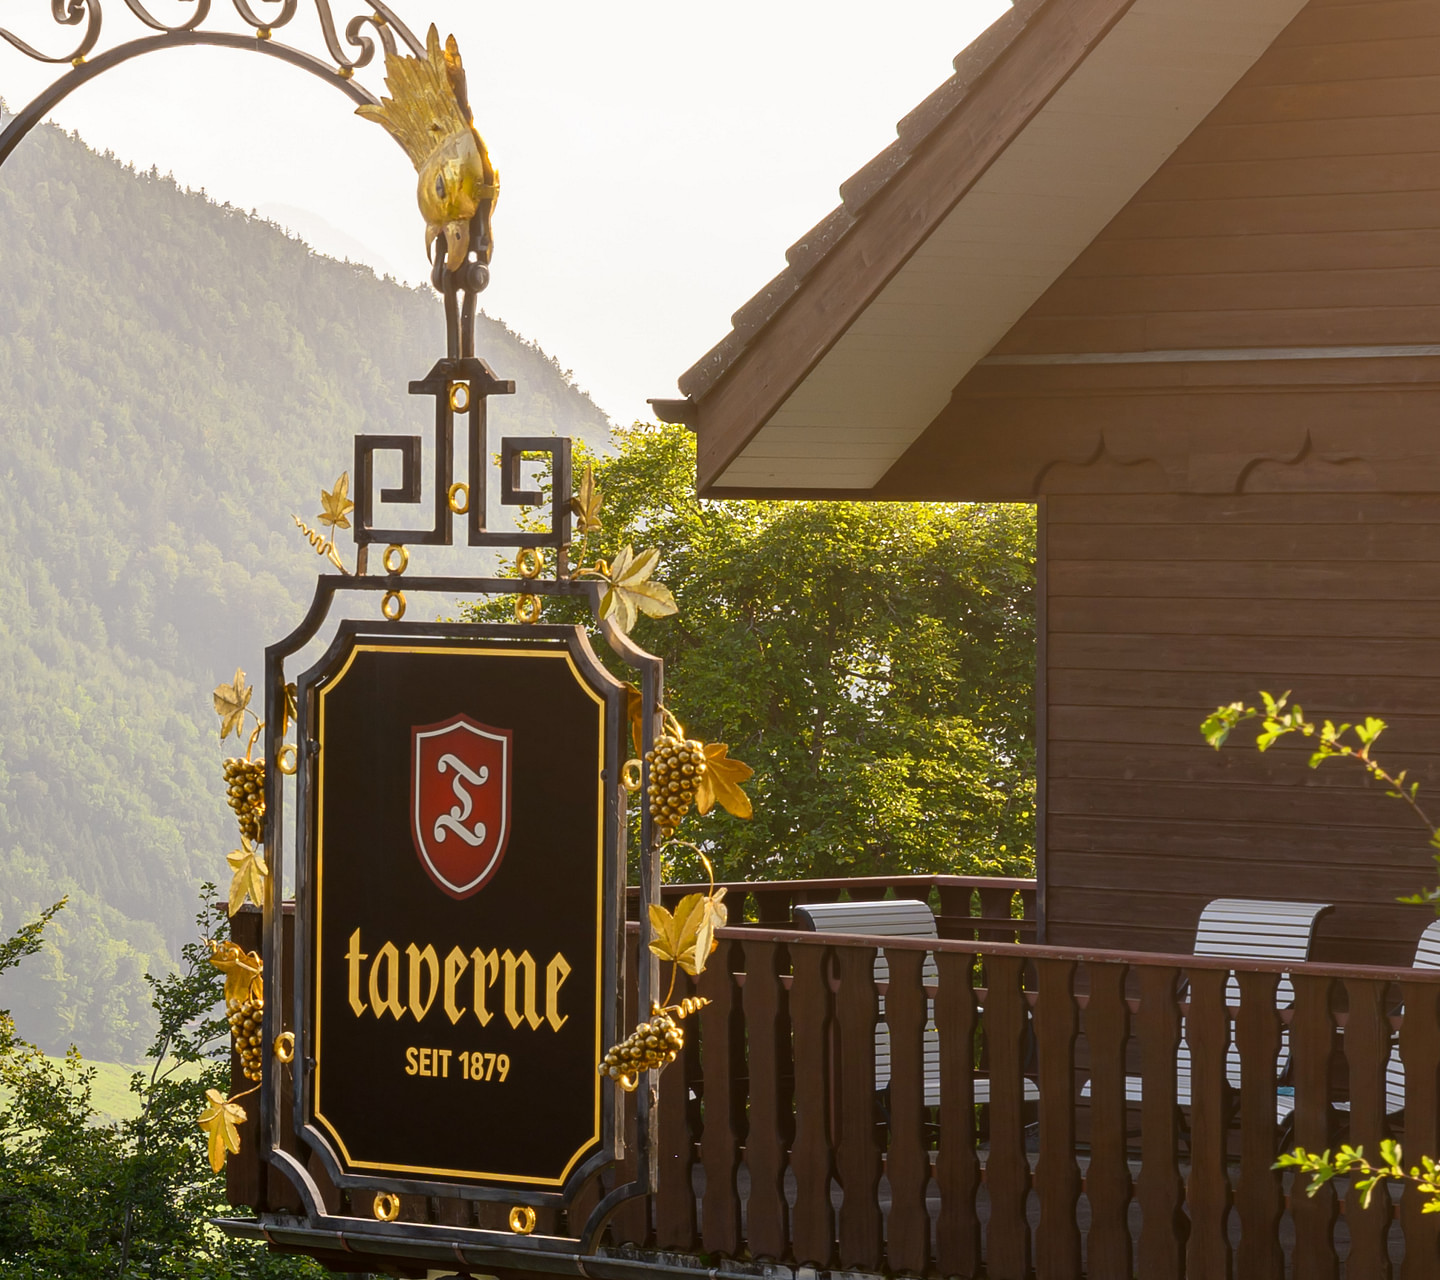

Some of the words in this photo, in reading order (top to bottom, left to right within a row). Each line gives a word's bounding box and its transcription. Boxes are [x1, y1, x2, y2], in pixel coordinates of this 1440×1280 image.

[344, 927, 572, 1033] taverne
[405, 1046, 453, 1078] SEIT
[458, 1050, 510, 1083] 1879
